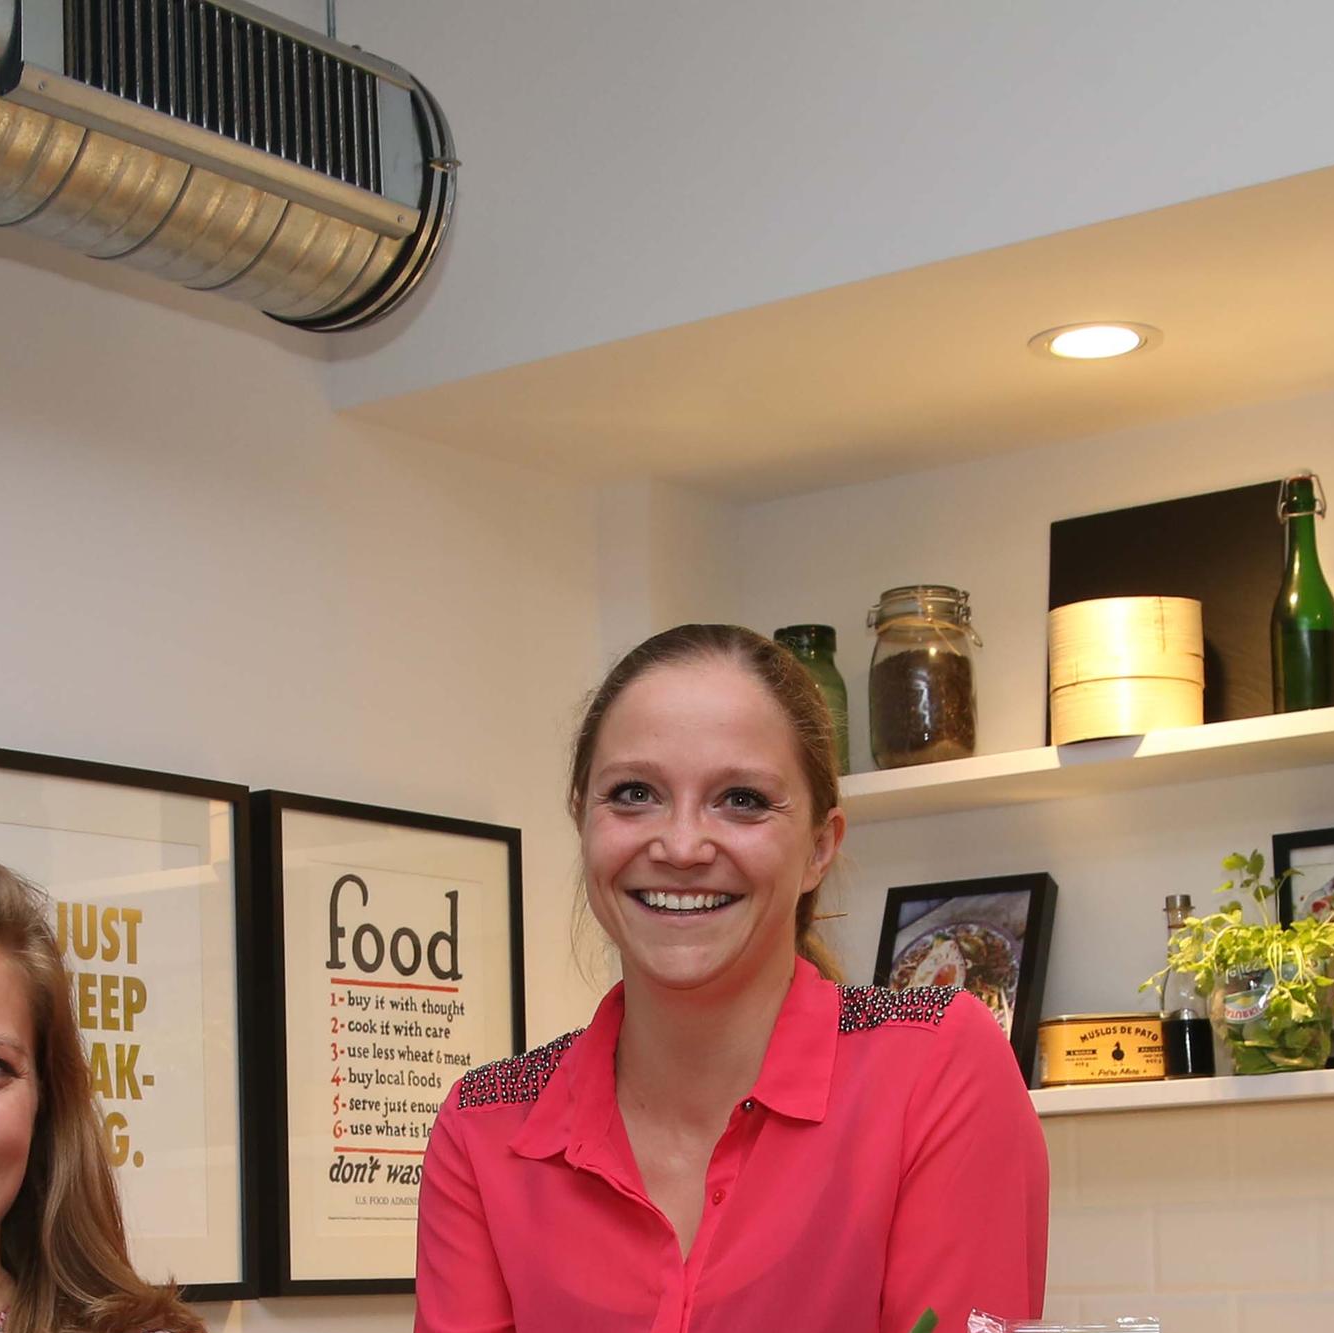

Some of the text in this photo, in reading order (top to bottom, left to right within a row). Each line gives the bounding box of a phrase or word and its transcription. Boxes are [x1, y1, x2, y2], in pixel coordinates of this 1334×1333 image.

[326, 874, 463, 981] food
[348, 990, 371, 1011] buy
[375, 994, 385, 1010] it
[389, 996, 418, 1013] with
[422, 998, 465, 1023] thought
[348, 1019, 377, 1034] cook
[380, 1020, 391, 1036] it
[394, 1021, 423, 1038] with
[425, 1027, 451, 1039] care
[1080, 1025, 1159, 1043] MUSLOS DE PATO
[347, 1045, 370, 1059] use
[372, 1043, 395, 1060] less
[398, 1045, 434, 1063] wheat
[444, 1053, 471, 1066] meat
[348, 1068, 374, 1089] buy
[375, 1069, 404, 1086] local
[407, 1070, 442, 1089] foods
[349, 1097, 381, 1112] serve
[382, 1096, 408, 1119] just
[349, 1123, 373, 1136] use
[375, 1121, 407, 1138] what
[409, 1122, 420, 1139] is
[329, 1154, 381, 1184] don't
[369, 1196, 390, 1206] FOOD
